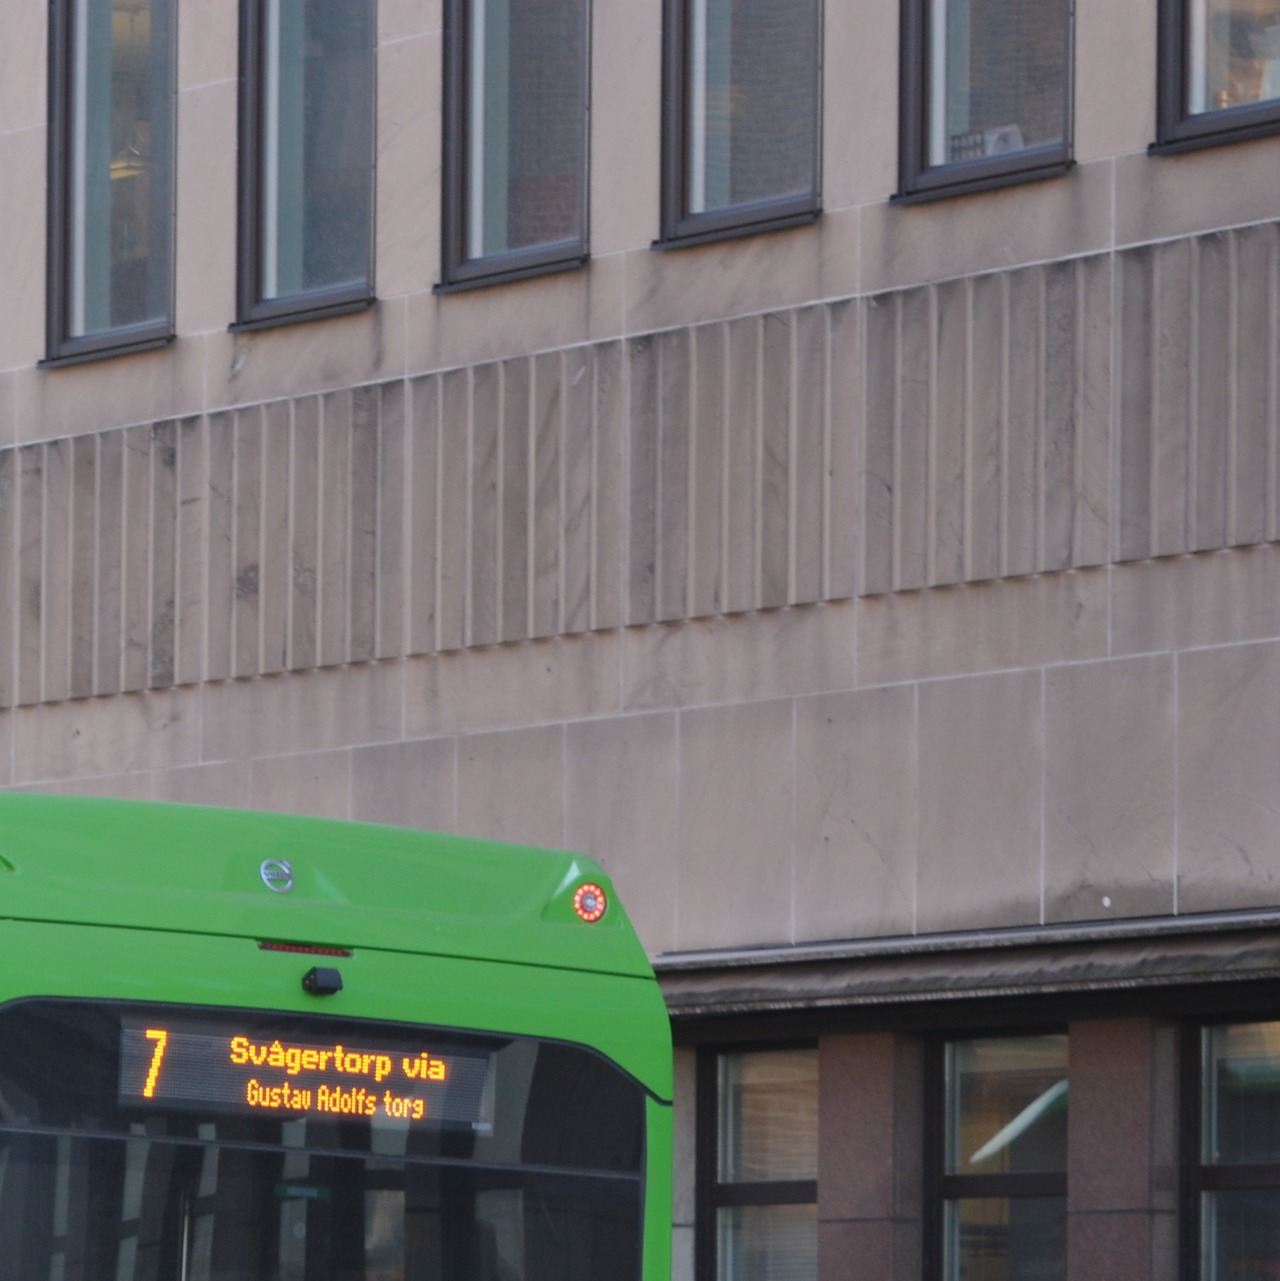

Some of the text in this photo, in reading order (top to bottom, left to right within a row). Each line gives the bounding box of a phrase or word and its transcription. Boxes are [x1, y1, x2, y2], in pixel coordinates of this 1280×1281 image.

[143, 1029, 168, 1098] 7
[230, 1036, 446, 1082] Svågertorp via
[246, 1078, 424, 1119] Gustav Adolfs torg
